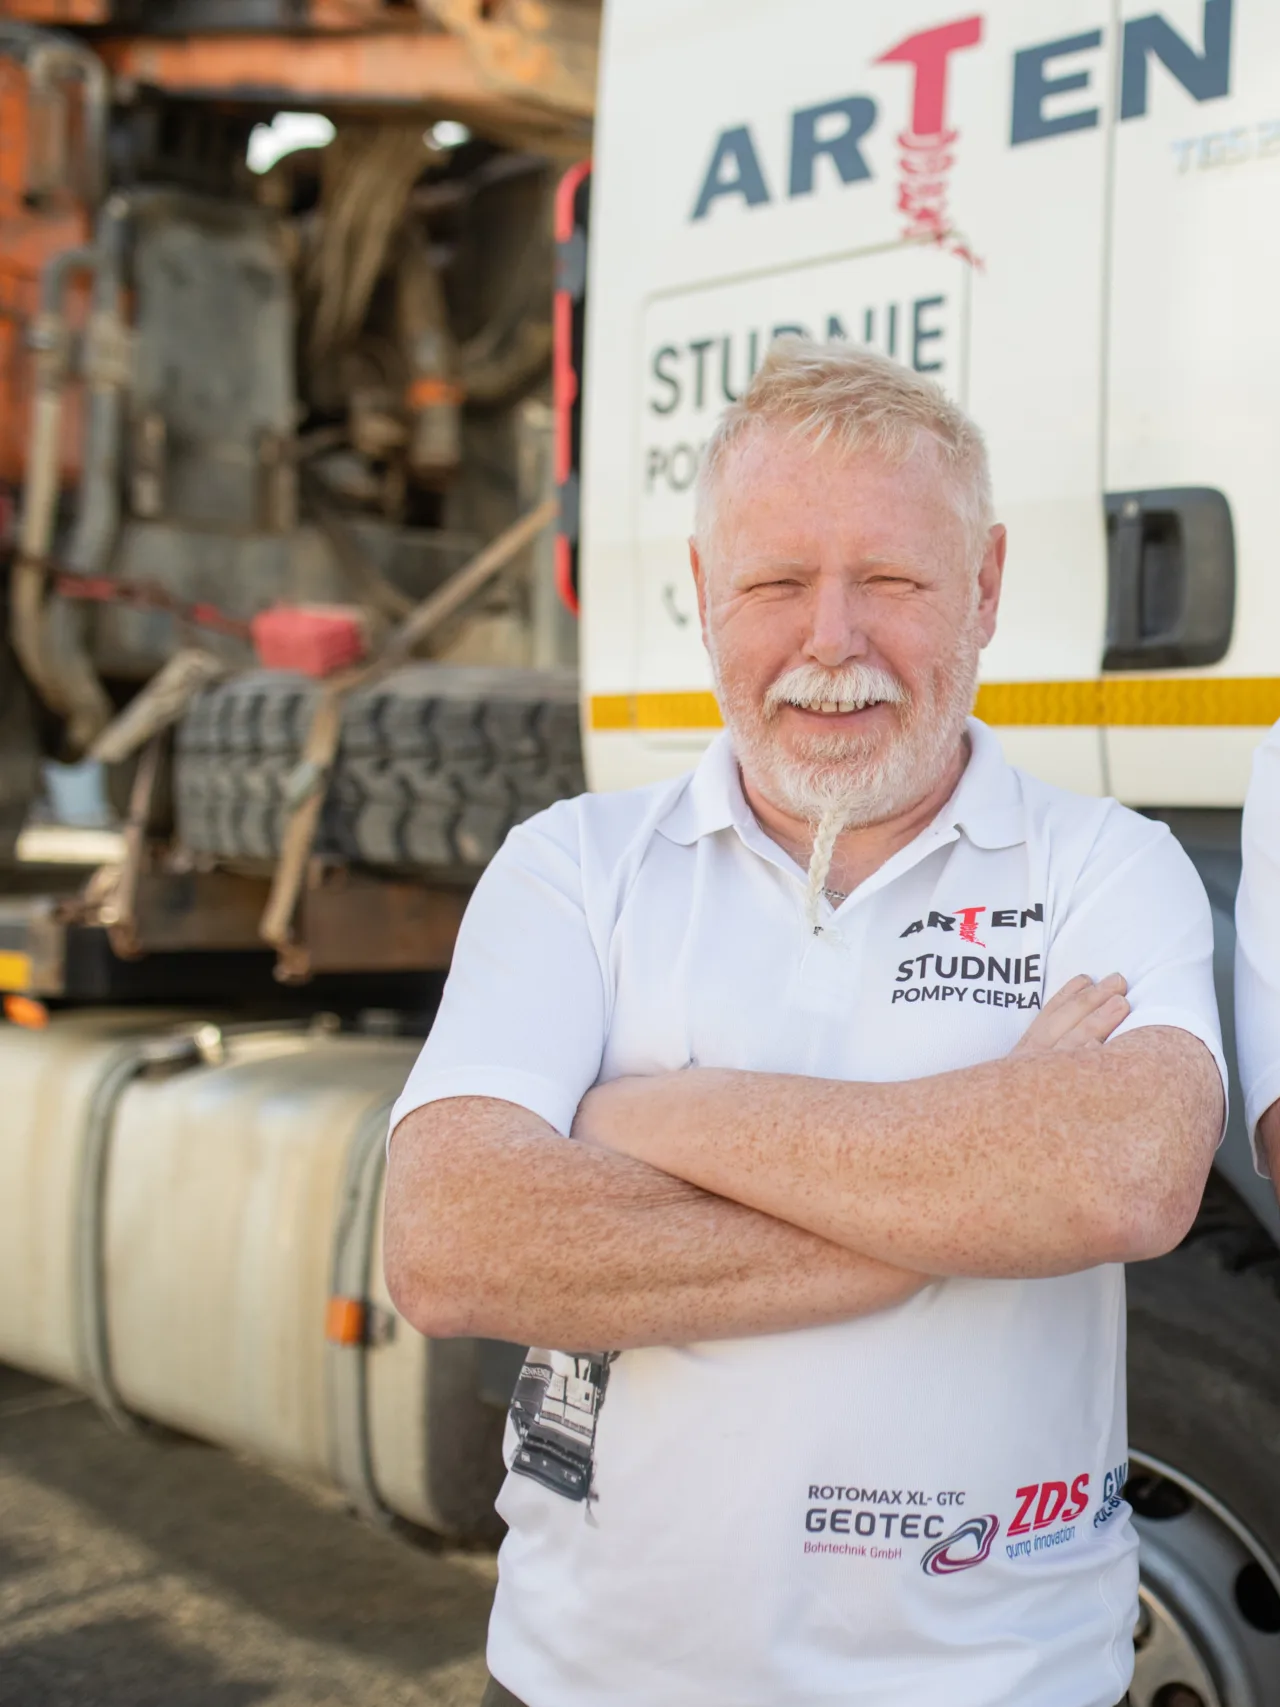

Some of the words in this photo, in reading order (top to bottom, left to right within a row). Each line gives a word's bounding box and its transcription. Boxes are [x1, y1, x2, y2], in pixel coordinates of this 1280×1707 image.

[686, 0, 1235, 270] ARTEN
[899, 903, 1044, 948] ARTEN
[895, 953, 1042, 985] STUDNIE
[891, 985, 968, 1004] POMPY
[972, 988, 1042, 1010] CIEPŁA
[808, 1485, 903, 1505] ROTOMAX
[936, 1491, 966, 1506] GTC
[1006, 1473, 1090, 1538] ZDS
[805, 1508, 945, 1540] GEOTEC
[803, 1541, 867, 1557] Bohrtechnik
[870, 1547, 902, 1560] GmbH
[1006, 1540, 1032, 1560] pump
[1034, 1525, 1076, 1550] innovation
